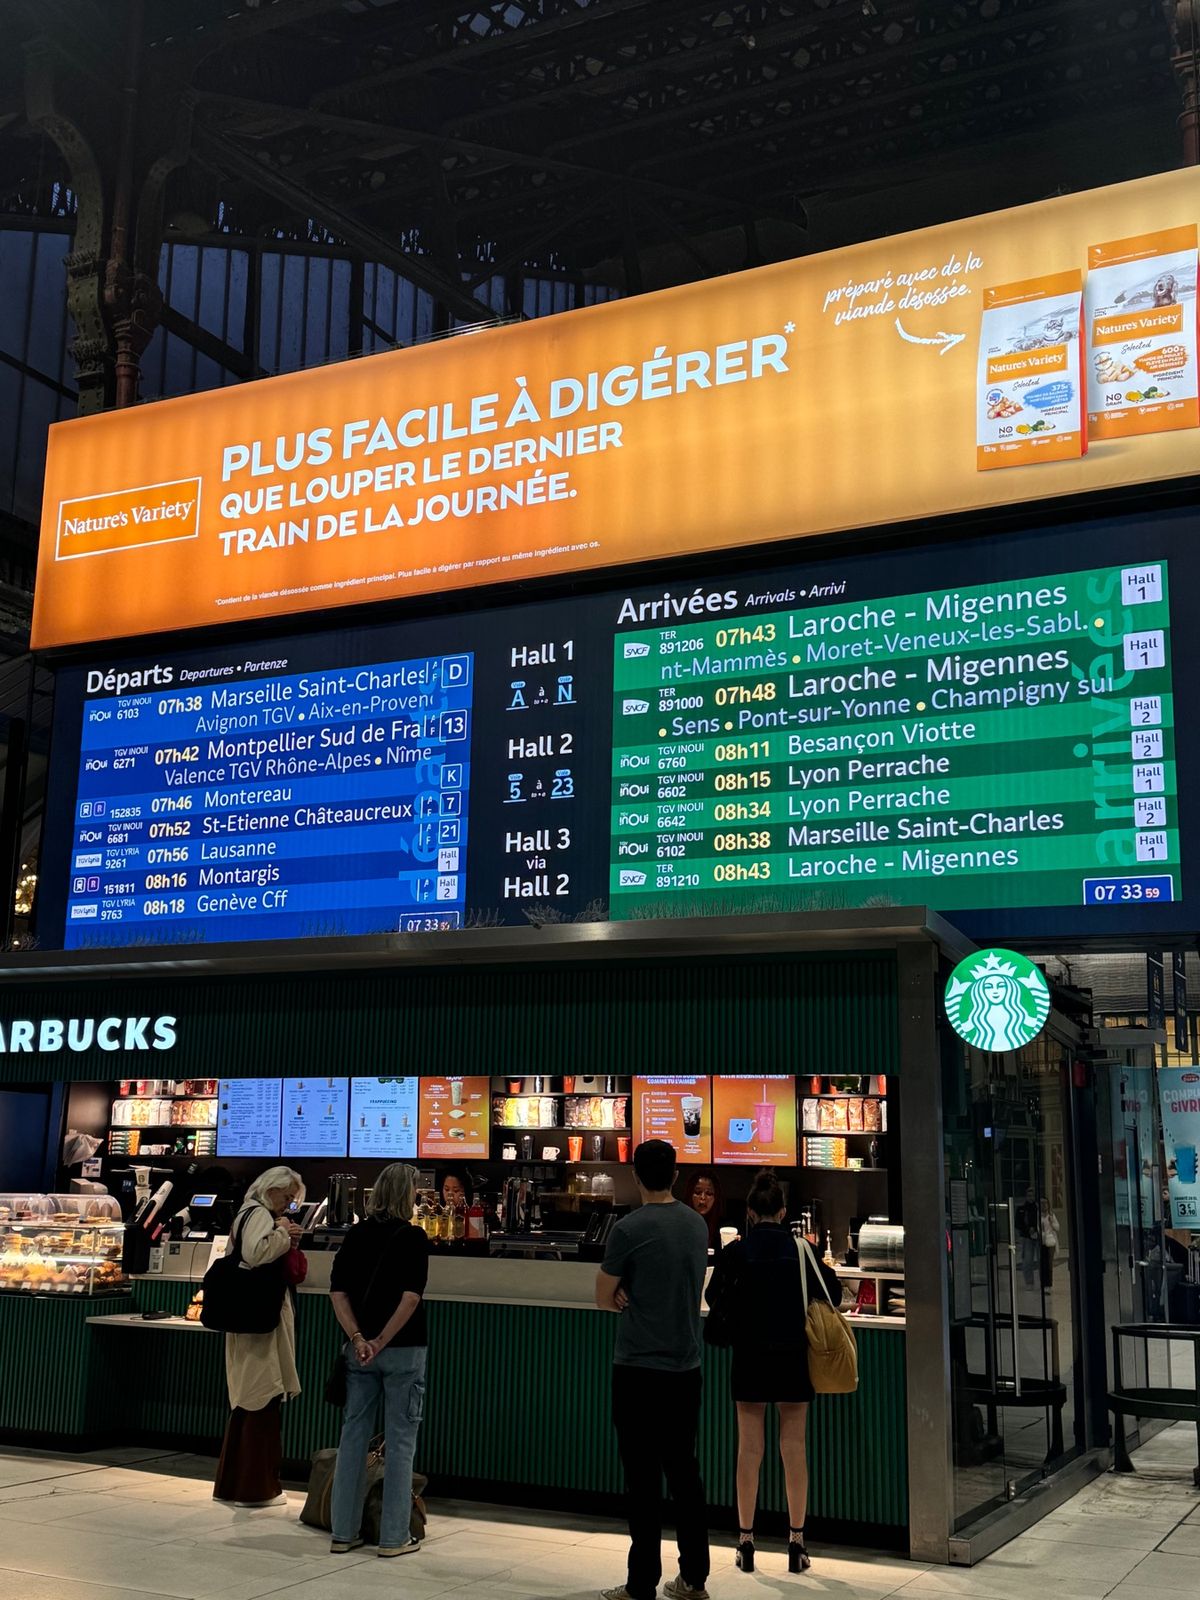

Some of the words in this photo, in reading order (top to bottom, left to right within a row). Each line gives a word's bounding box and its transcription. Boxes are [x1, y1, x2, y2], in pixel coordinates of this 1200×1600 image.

[823, 270, 894, 313] préparé
[896, 266, 939, 287] avec
[941, 254, 962, 276] de
[965, 251, 983, 273] la
[834, 292, 896, 326] viande
[899, 279, 972, 310] désossée.
[1096, 321, 1138, 336] Nature's
[1139, 314, 1179, 328] Variety
[1028, 353, 1064, 367] Variety
[1106, 393, 1122, 402] NO
[221, 427, 333, 482] PLUS
[343, 393, 499, 460] FACILE
[504, 375, 541, 428] À
[220, 484, 284, 519] QUE
[289, 461, 416, 508] LOUPER
[422, 451, 462, 484] LE
[468, 421, 624, 476] DERNIER
[63, 511, 129, 536] Nature's
[131, 500, 195, 524] Variety
[218, 517, 310, 557] TRAIN
[316, 510, 358, 541] DE
[364, 503, 404, 533] LA
[407, 468, 578, 526] JOURNÉE.
[243, 594, 251, 602] de
[258, 590, 279, 599] viande
[280, 586, 309, 596] désossée
[310, 582, 333, 591] comme
[334, 576, 366, 589] ingrédient
[398, 569, 413, 578] Plus
[414, 567, 431, 576] facile
[438, 563, 462, 573] digérer
[463, 561, 475, 569] par
[475, 557, 500, 566] rapport
[512, 551, 533, 560] même
[534, 545, 570, 557] ingrédient
[571, 543, 589, 551] avec
[617, 588, 738, 625] Arrivées
[744, 589, 796, 608] Arrivals
[809, 581, 846, 599] Arrivi
[659, 638, 704, 655] 891206
[715, 624, 776, 648] 07h43
[789, 606, 896, 639] Laroche
[926, 585, 1068, 624] Migennes
[510, 642, 556, 668] Hall
[562, 640, 575, 661] 1
[661, 649, 788, 681] nt-Mammès
[806, 610, 1088, 663] Moret-Veneux-les-Sabl.
[86, 664, 174, 695] Départs
[179, 664, 235, 682] Departures
[243, 658, 289, 673] Partenze
[658, 695, 704, 712] 891000
[715, 682, 776, 706] 07h48
[789, 667, 897, 698] Laroche
[926, 649, 1070, 685] Migennes
[116, 708, 139, 720] 6103
[158, 695, 203, 716] 07h38
[210, 682, 293, 709] Marseille
[298, 667, 425, 699] Saint-Charles
[449, 663, 463, 680] D
[117, 699, 132, 708] TGV
[132, 696, 152, 707] INOUI
[511, 689, 525, 707] A
[557, 684, 572, 703] N
[671, 717, 720, 737] Sens
[738, 698, 911, 730] Pont-sur-Yonne
[931, 680, 1070, 711] Champigny
[195, 714, 258, 735] Avignon
[262, 705, 296, 725] TGV
[113, 757, 136, 770] 6271
[154, 745, 200, 765] 07h42
[207, 731, 315, 761] Montpellier
[320, 725, 355, 749] Sud
[361, 723, 385, 744] de
[444, 717, 464, 734] 13
[508, 735, 553, 759] Hall
[559, 733, 573, 755] 2
[658, 756, 687, 769] 6760
[714, 740, 770, 761] 08h11
[789, 729, 895, 755] Besançon
[901, 721, 976, 745] Viotte
[165, 765, 226, 786] Valence
[229, 760, 262, 780] TGV
[266, 753, 371, 777] Rhône-Alpes
[657, 786, 687, 799] 6602
[714, 770, 771, 792] 08h15
[788, 765, 840, 790] Lyon
[848, 753, 950, 781] Perrache
[109, 806, 142, 820] 152835
[151, 795, 193, 814] 07h46
[204, 787, 292, 808] Montereau
[447, 769, 457, 783] K
[510, 781, 521, 800] 5
[551, 777, 574, 796] 23
[657, 815, 686, 828] 6642
[714, 800, 771, 821] 08h34
[788, 796, 840, 820] Lyon
[848, 785, 950, 811] Perrache
[107, 833, 129, 844] 6681
[149, 820, 191, 839] 07h52
[202, 812, 290, 834] St-Etienne
[294, 803, 413, 827] Châteaucreux
[446, 797, 455, 810] 7
[656, 845, 686, 858] 6102
[713, 831, 771, 851] 08h38
[788, 820, 890, 847] Marseille
[896, 810, 1065, 840] Saint-Charles
[105, 858, 127, 869] 9261
[147, 847, 189, 864] 07h56
[201, 842, 277, 860] Lausanne
[441, 824, 457, 838] 21
[106, 848, 120, 857] TGV
[120, 847, 140, 856] LYRIA
[505, 829, 551, 853] Hall
[556, 828, 570, 850] 3
[103, 882, 135, 895] 151811
[145, 872, 188, 890] 08h16
[198, 864, 280, 886] Montargis
[526, 855, 547, 870] via
[656, 874, 700, 888] 891210
[713, 861, 771, 882] 08h43
[788, 854, 877, 878] Laroche
[902, 848, 1019, 875] Migennes
[503, 875, 550, 898] Hall
[555, 873, 570, 895] 2
[1094, 885, 1116, 901] 07
[1121, 884, 1142, 899] 33
[1145, 887, 1160, 898] 59
[100, 910, 123, 921] 9763
[143, 898, 186, 916] 08h18
[196, 894, 257, 913] Genève
[262, 890, 289, 908] Cff
[424, 918, 438, 931] 33
